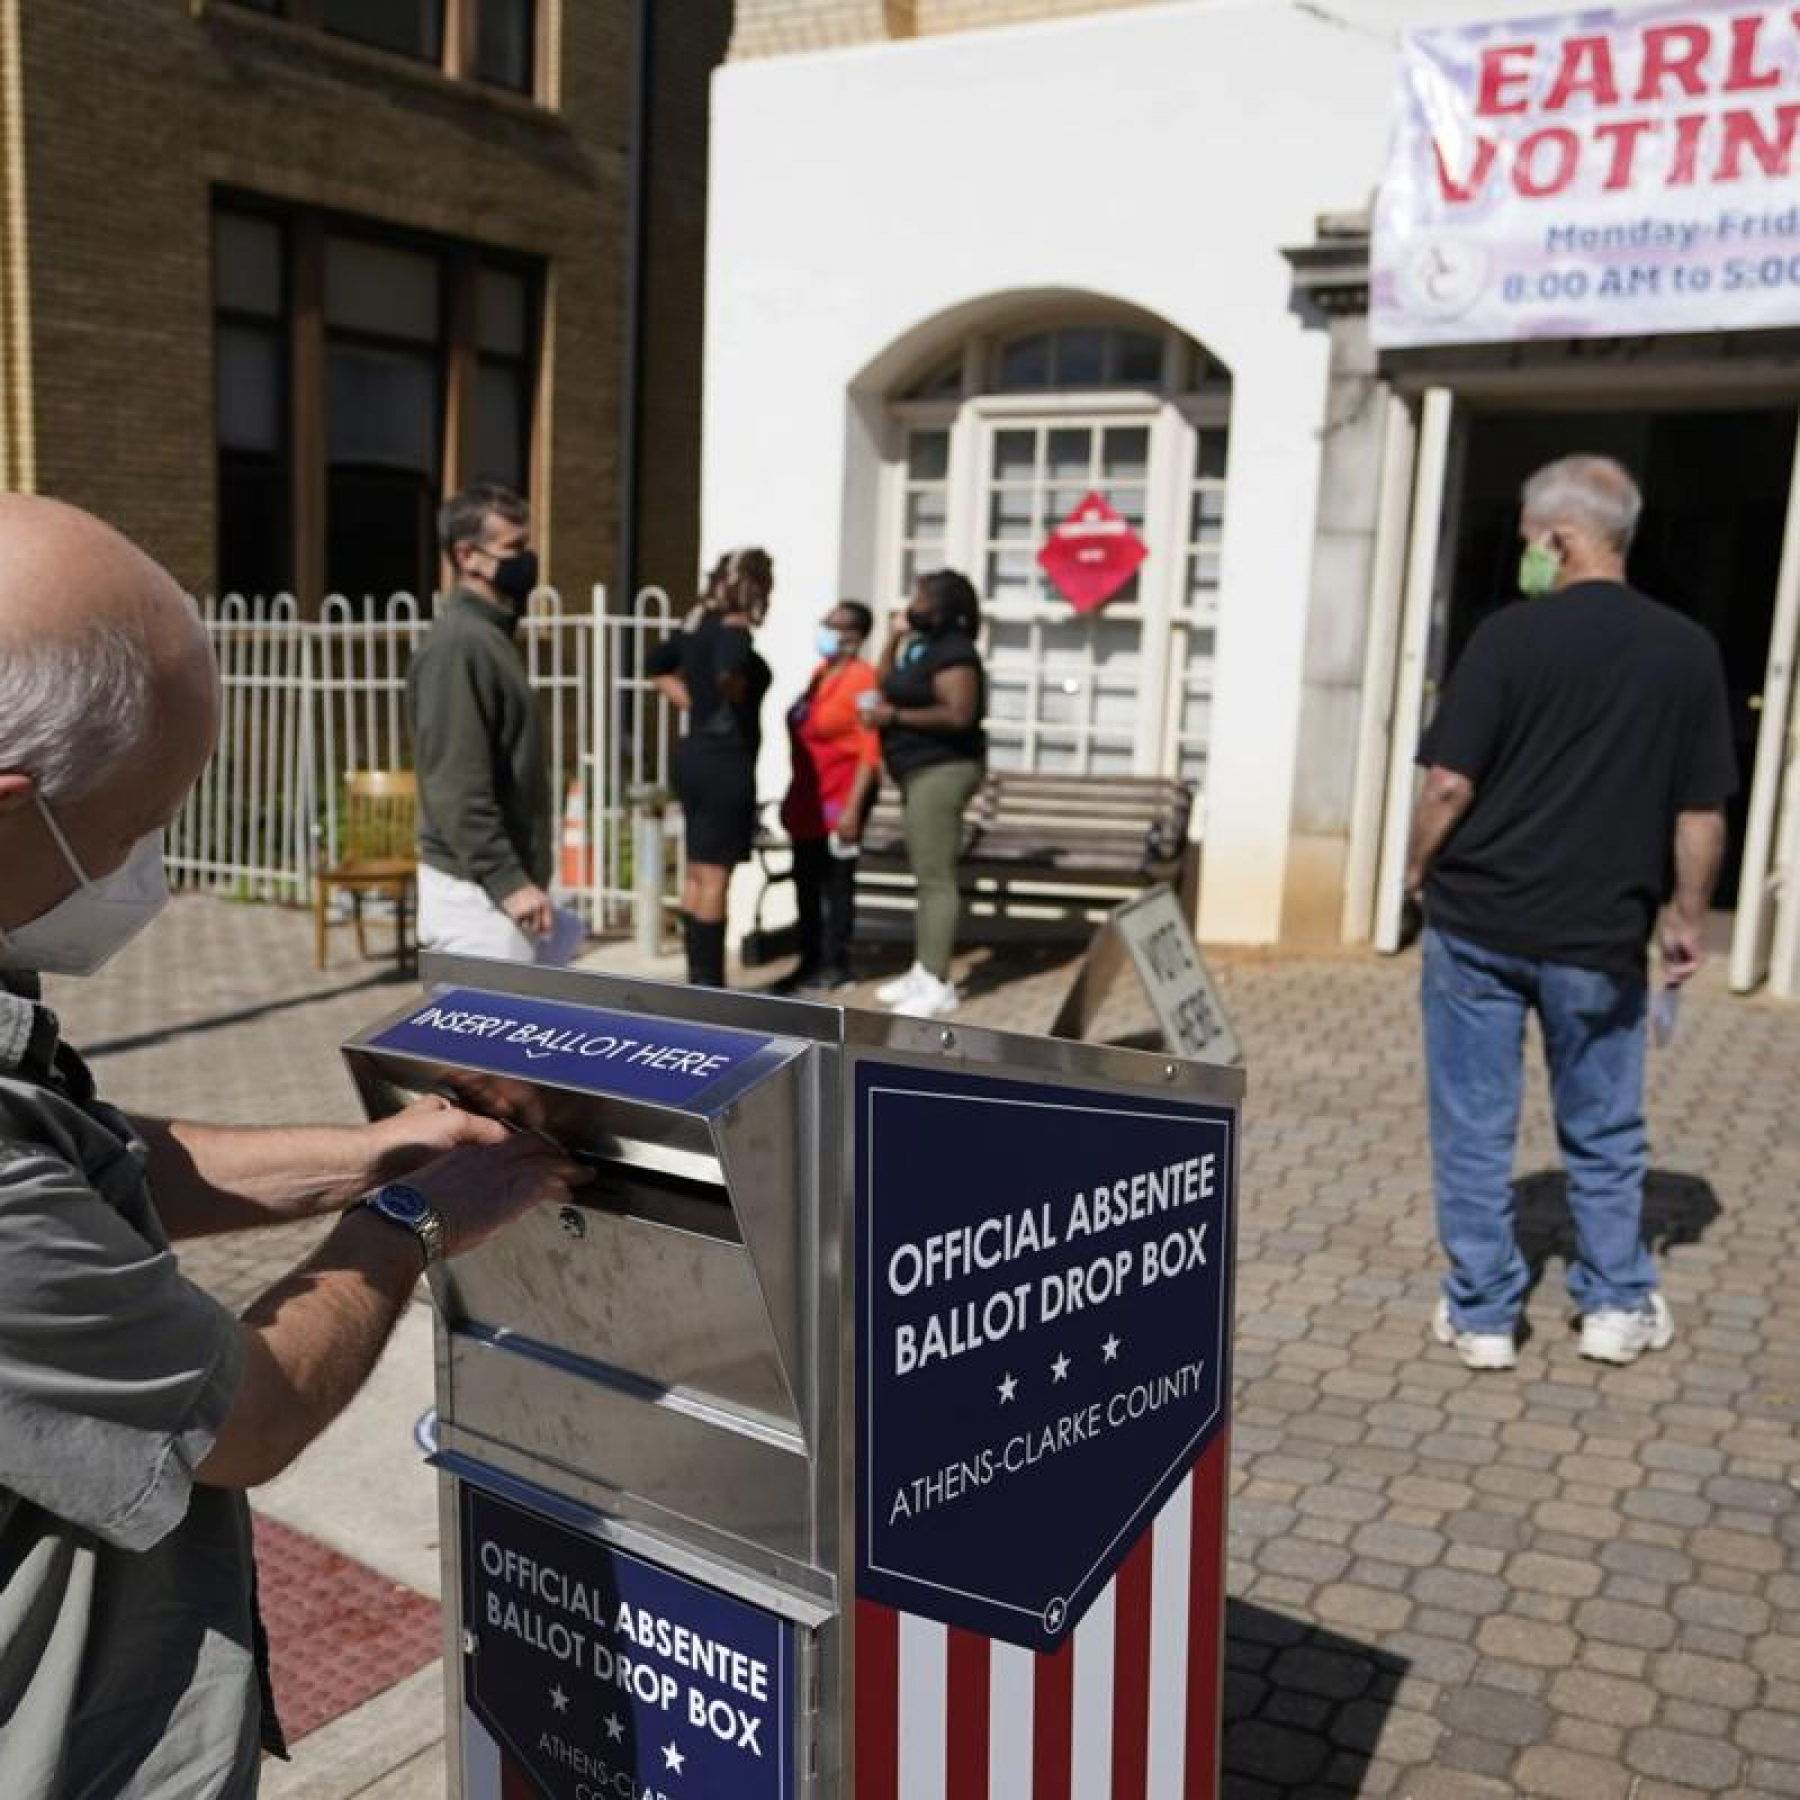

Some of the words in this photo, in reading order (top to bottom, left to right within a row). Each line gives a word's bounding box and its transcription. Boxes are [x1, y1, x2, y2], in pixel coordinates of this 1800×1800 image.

[1475, 9, 1800, 118] EARL
[1599, 265, 1661, 296] AM
[1673, 264, 1712, 292] to
[411, 1007, 518, 1038] INSERT
[506, 1023, 638, 1060] BALLOT
[627, 1043, 730, 1077] HERE
[888, 1202, 1057, 1297] OFFICIAL
[1065, 1152, 1216, 1242] ABSENTEE
[894, 1282, 1032, 1377] BALLOT
[1040, 1249, 1133, 1325] DROP
[1141, 1222, 1207, 1287] BOX
[887, 1402, 1102, 1527] ATHENS-CLARKE
[1107, 1358, 1206, 1429] COUNTY
[480, 1540, 606, 1627] OFFICIAL
[614, 1600, 770, 1702] ABSENTEE
[485, 1590, 586, 1668] BALLOT
[593, 1642, 679, 1711] DROP
[688, 1687, 762, 1757] BOX
